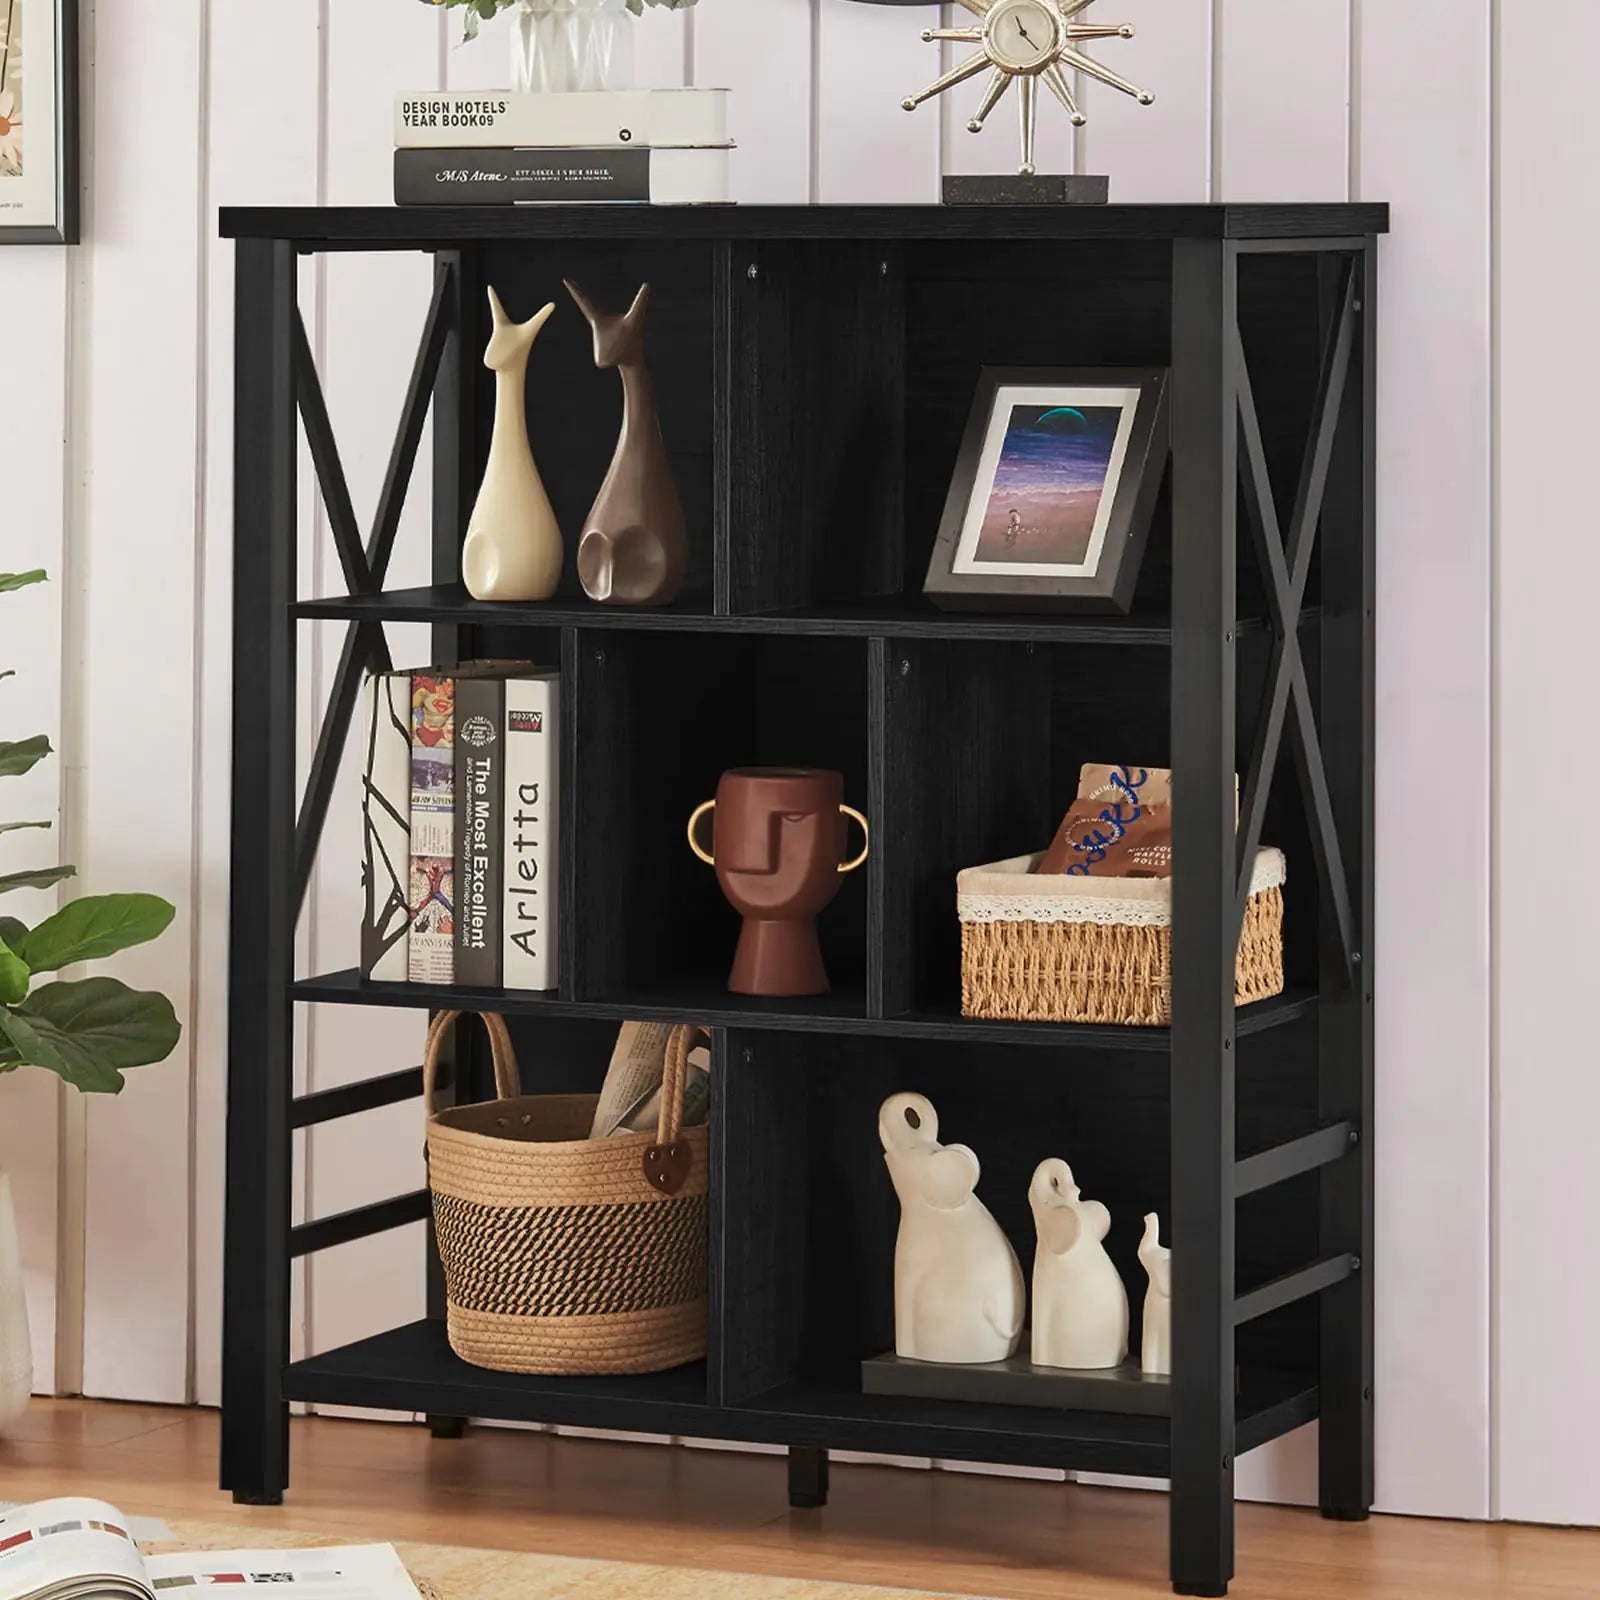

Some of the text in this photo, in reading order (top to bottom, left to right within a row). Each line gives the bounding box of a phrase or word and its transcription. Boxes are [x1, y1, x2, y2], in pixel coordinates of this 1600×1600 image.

[403, 101, 506, 114] DESIGN HOTELS
[403, 114, 494, 127] YEAR BOOK09
[475, 757, 491, 795] The
[473, 800, 490, 850] Most
[508, 783, 538, 957] Arletta
[1132, 857, 1166, 866] ROLLS
[471, 855, 489, 949] Excellent
